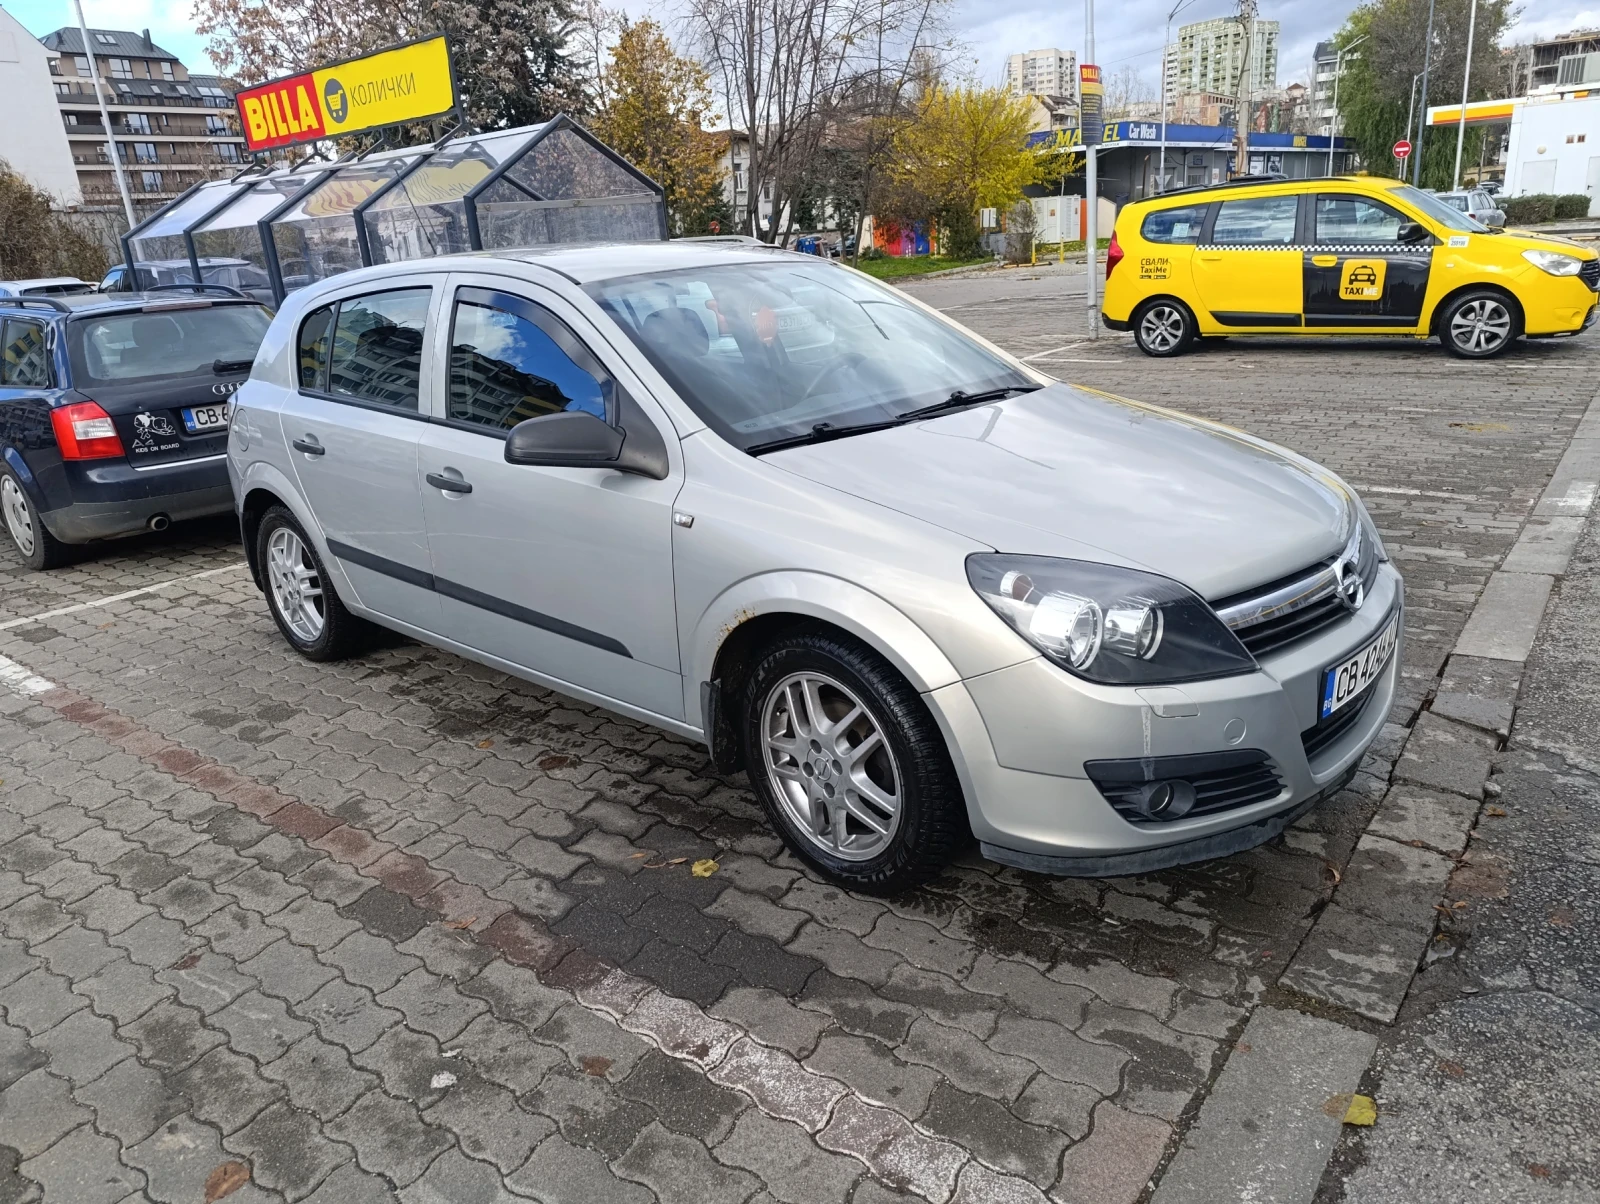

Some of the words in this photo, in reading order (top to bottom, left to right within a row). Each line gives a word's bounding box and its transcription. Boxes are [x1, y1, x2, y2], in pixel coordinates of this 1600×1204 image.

[349, 71, 417, 107] КОЛИЧКИ
[243, 84, 319, 142] BILLA
[1128, 123, 1140, 139] Car
[1140, 123, 1156, 139] Wash
[1140, 257, 1169, 266] СВАЛИ
[1140, 266, 1168, 274] TaxiMe
[160, 442, 180, 451] BOARD
